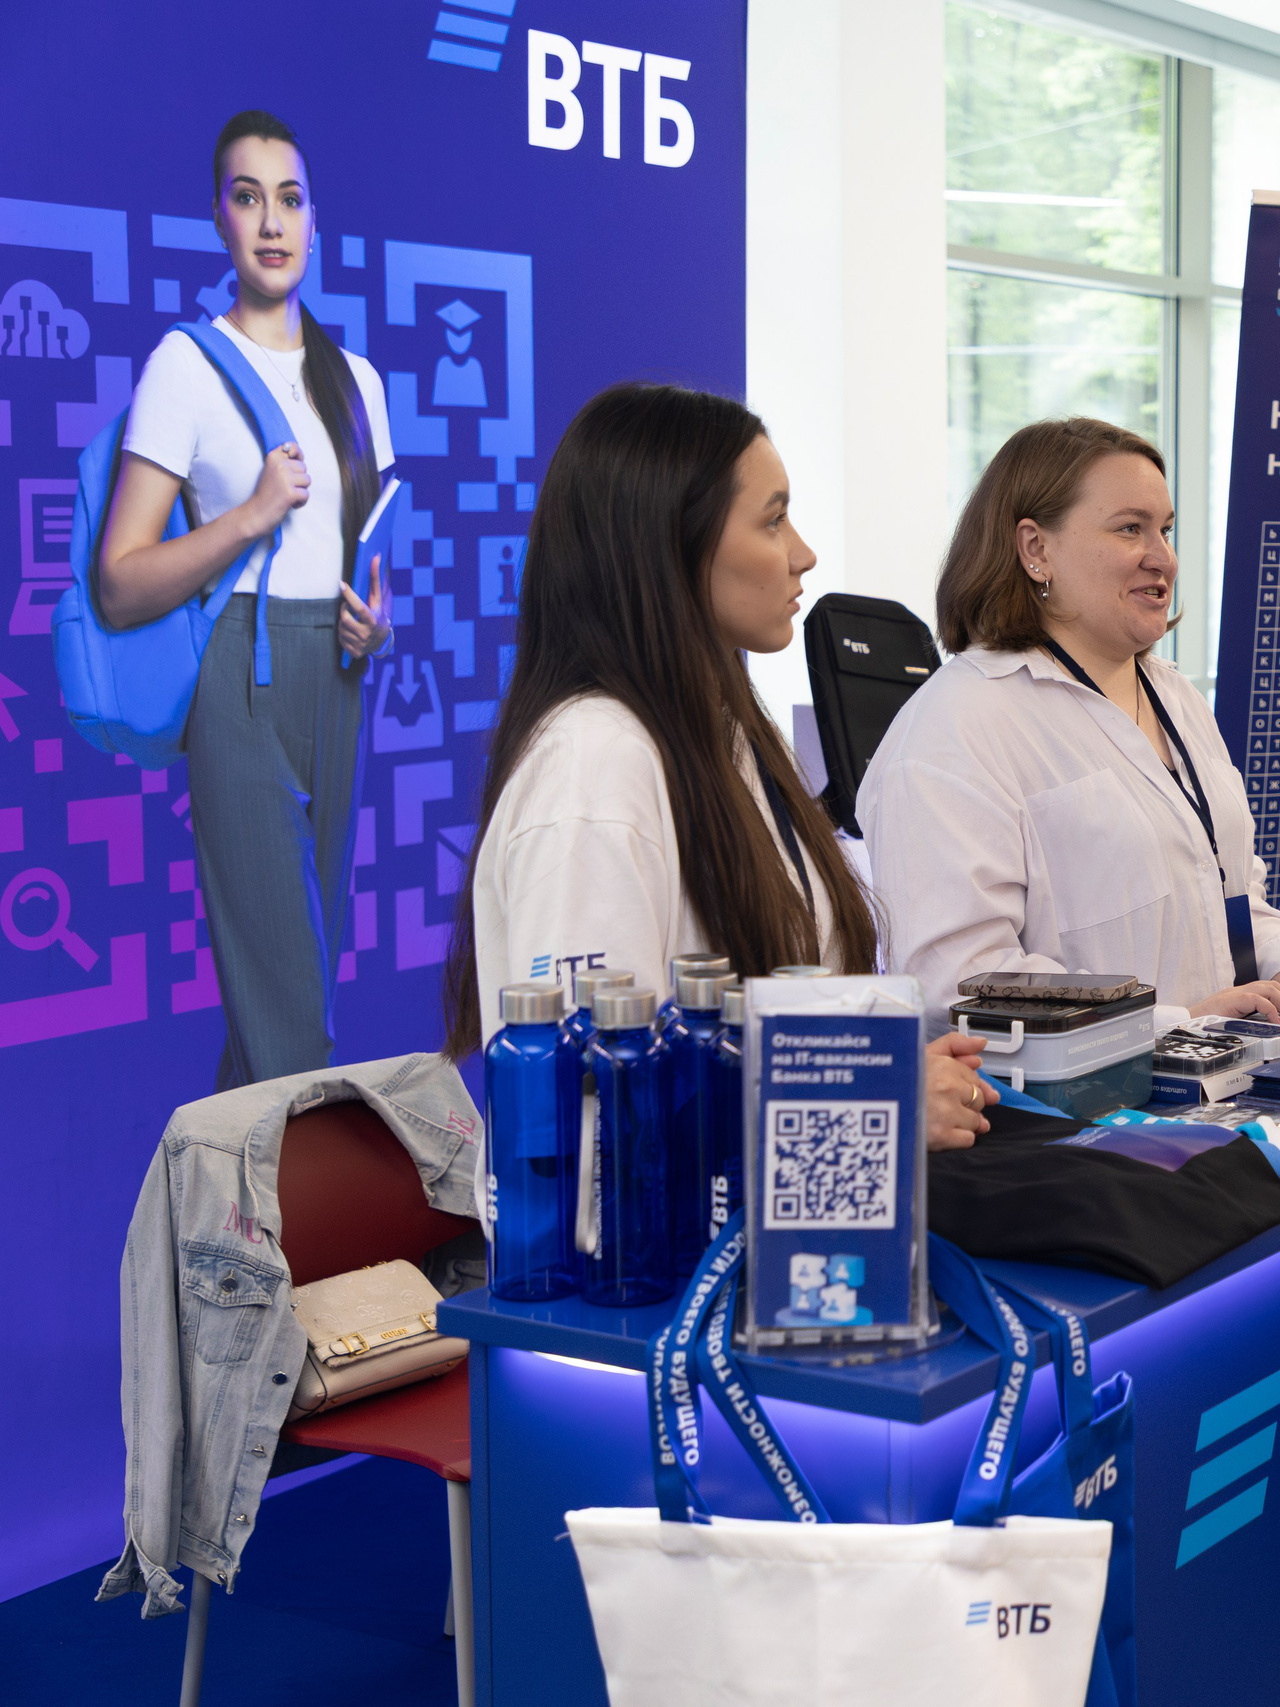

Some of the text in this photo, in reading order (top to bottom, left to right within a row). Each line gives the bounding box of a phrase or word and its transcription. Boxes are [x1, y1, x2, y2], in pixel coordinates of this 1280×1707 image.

[528, 28, 695, 169] ВТБ
[771, 1053, 793, 1066] на
[772, 1033, 870, 1048] Откликайся
[771, 1069, 854, 1084] Банка ВТБ
[487, 1173, 498, 1221] ВТБ
[711, 1175, 728, 1224] ВТБ
[675, 1273, 719, 1346] ТВОЕГО
[669, 1351, 700, 1466] БУДУЩЕГО
[707, 1312, 817, 1524] ОЗМОЖНОСТИ ТВОЕГО
[979, 1360, 1026, 1480] БУДУЩЕГО
[1084, 1455, 1118, 1509] ВТБ
[996, 1603, 1052, 1638] ВТБ
